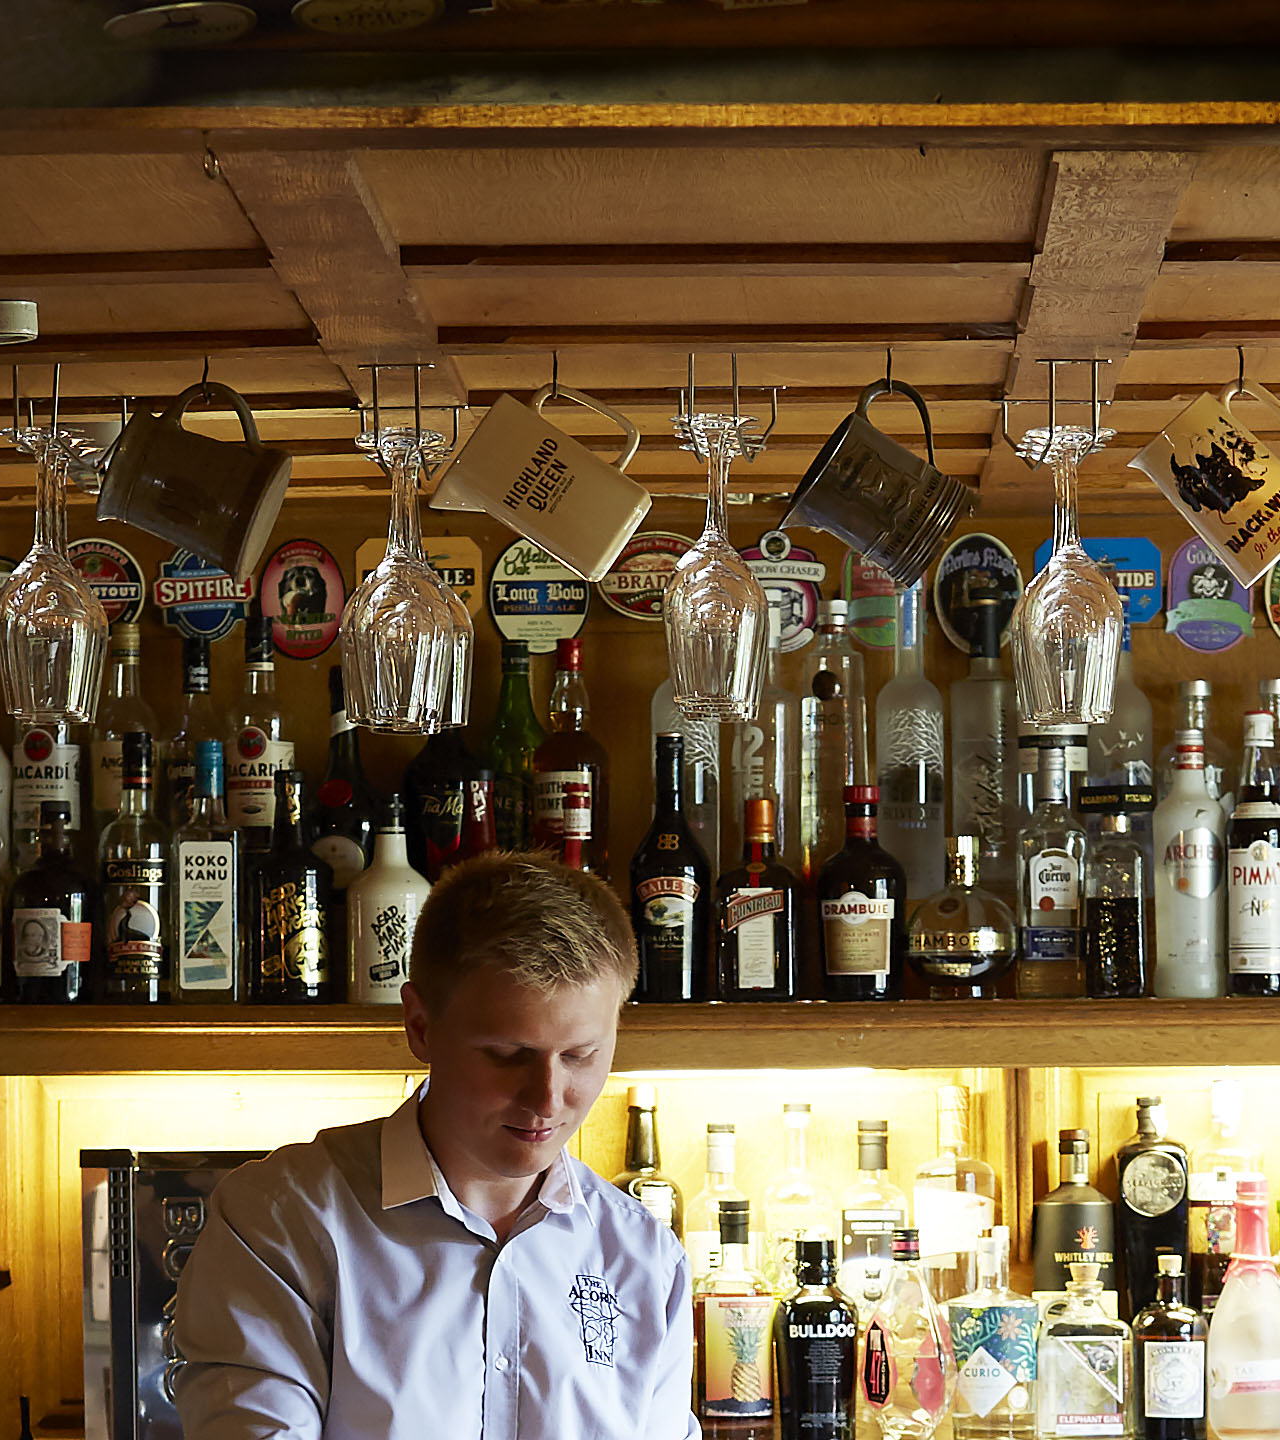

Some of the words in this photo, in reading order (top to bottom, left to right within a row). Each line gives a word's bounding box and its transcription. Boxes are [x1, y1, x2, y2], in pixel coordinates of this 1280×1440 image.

[502, 436, 559, 512] HIGHLAND
[525, 458, 569, 513] QUEEN
[782, 562, 820, 578] CHASER
[1115, 571, 1155, 588] TIDE
[92, 585, 138, 600] STOUT
[159, 577, 248, 603] SPITFIRE
[494, 580, 540, 605] Long
[546, 580, 586, 603] Bow
[554, 604, 576, 614] ALE
[184, 855, 228, 868] KOKO
[105, 862, 164, 883] Goslings
[184, 869, 228, 881] KANU
[1037, 868, 1071, 885] Cuervo
[731, 894, 781, 922] COINTREAU
[823, 904, 890, 916] DRAMBUIE
[372, 904, 399, 936] DEAD
[1054, 1252, 1091, 1263] WHITLEY
[567, 1284, 619, 1306] ACORN
[788, 1324, 856, 1339] BULLDOG
[586, 1344, 613, 1363] INN
[963, 1367, 1001, 1378] CURIO
[1058, 1415, 1102, 1425] ELEPHANT
[1103, 1415, 1121, 1425] GIN
